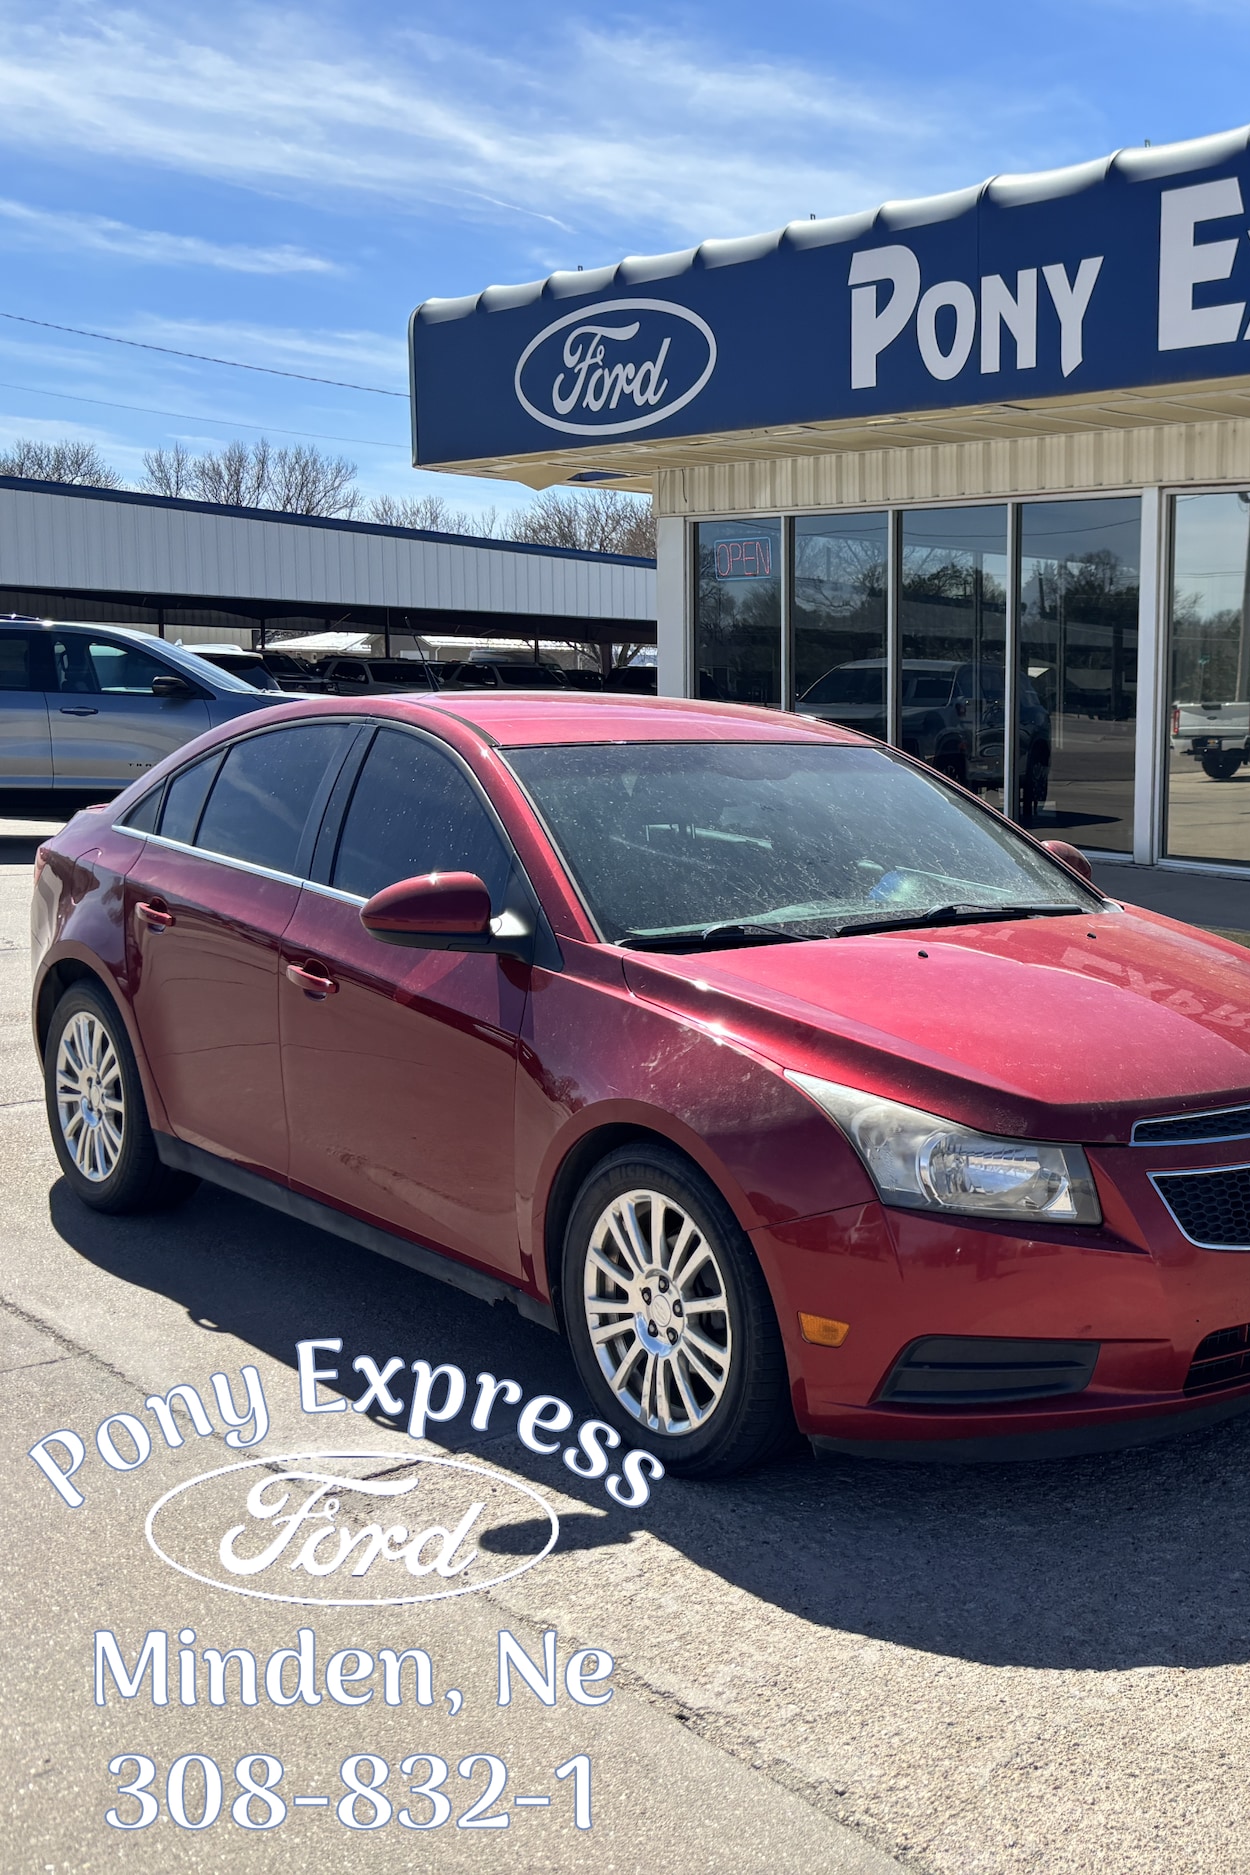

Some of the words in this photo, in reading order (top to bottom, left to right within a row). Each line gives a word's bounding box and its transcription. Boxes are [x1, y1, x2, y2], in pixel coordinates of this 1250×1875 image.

[847, 244, 1104, 390] PONY
[552, 320, 672, 415] Ford
[717, 541, 770, 577] OPEN
